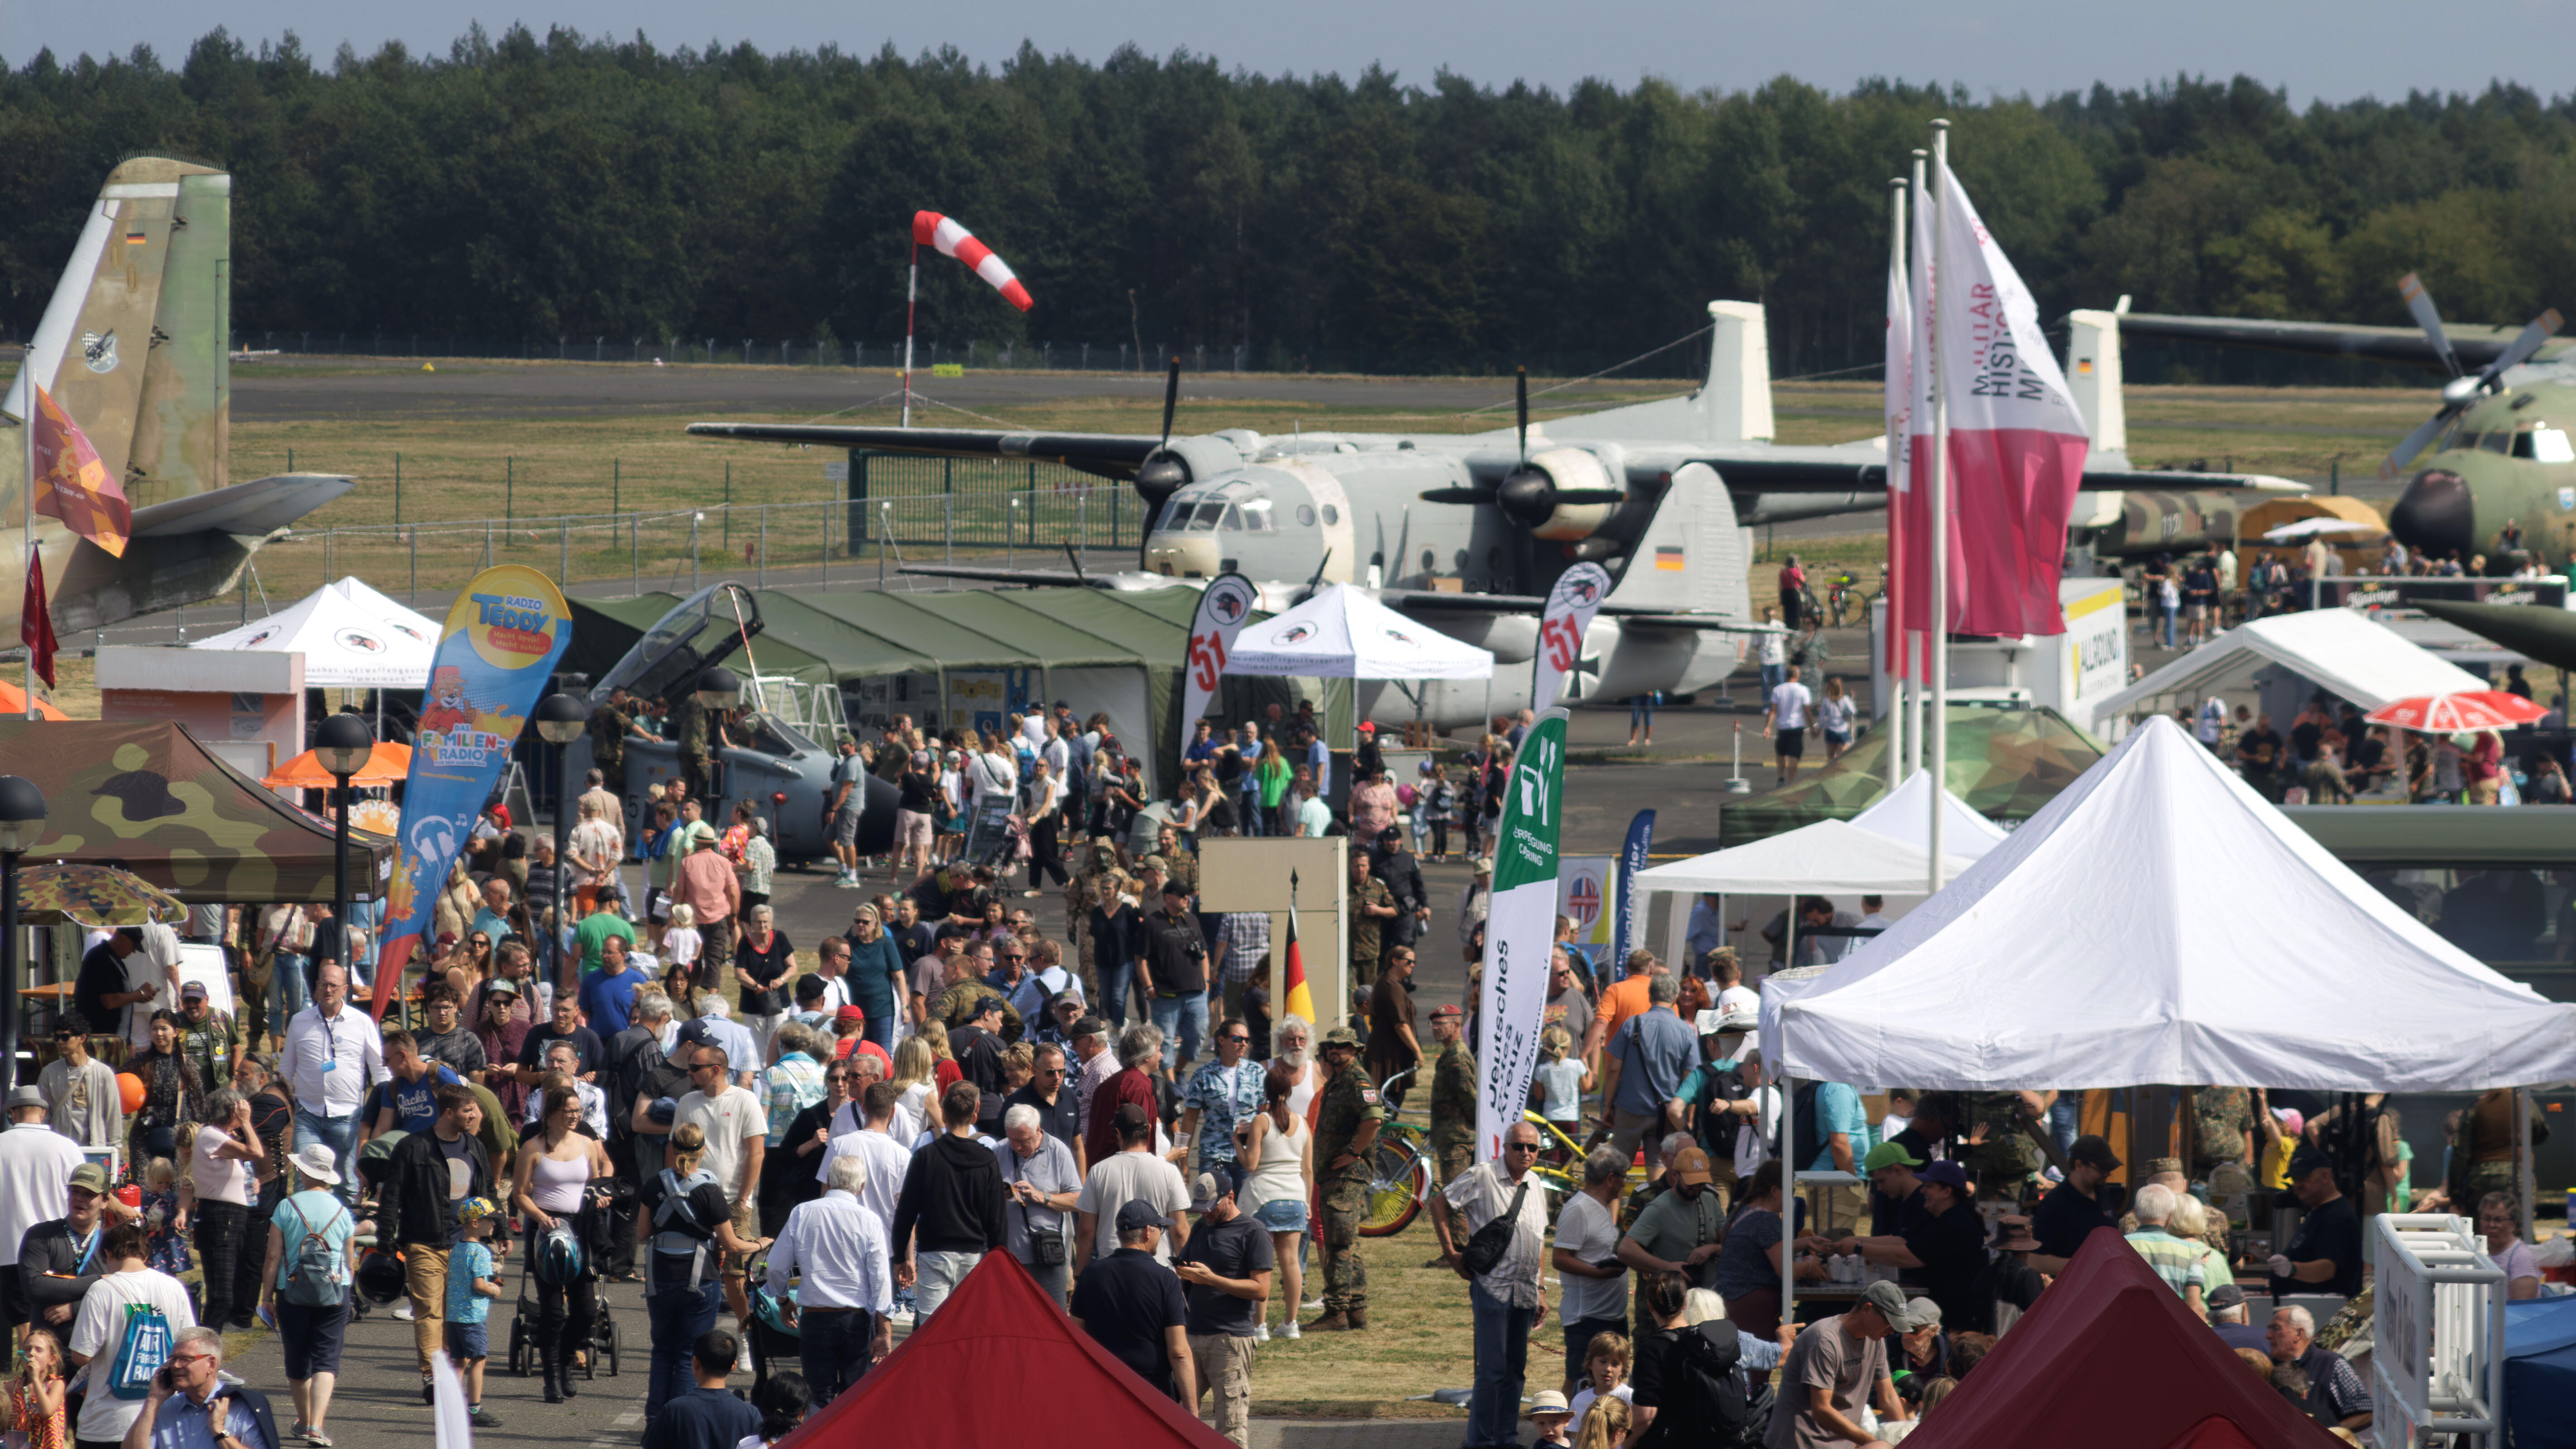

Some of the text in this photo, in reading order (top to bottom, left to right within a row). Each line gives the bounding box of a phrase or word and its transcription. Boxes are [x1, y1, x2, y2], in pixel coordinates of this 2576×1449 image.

[506, 596, 542, 610] RADIO
[471, 593, 549, 635] TEDDY
[1541, 613, 1582, 672] 51
[1190, 630, 1226, 692] 51
[423, 733, 506, 748] FAMILIEN-
[439, 748, 484, 760] RADIO
[628, 794, 639, 819] 5
[139, 1332, 159, 1352] AIR
[136, 1353, 159, 1365] FORCE
